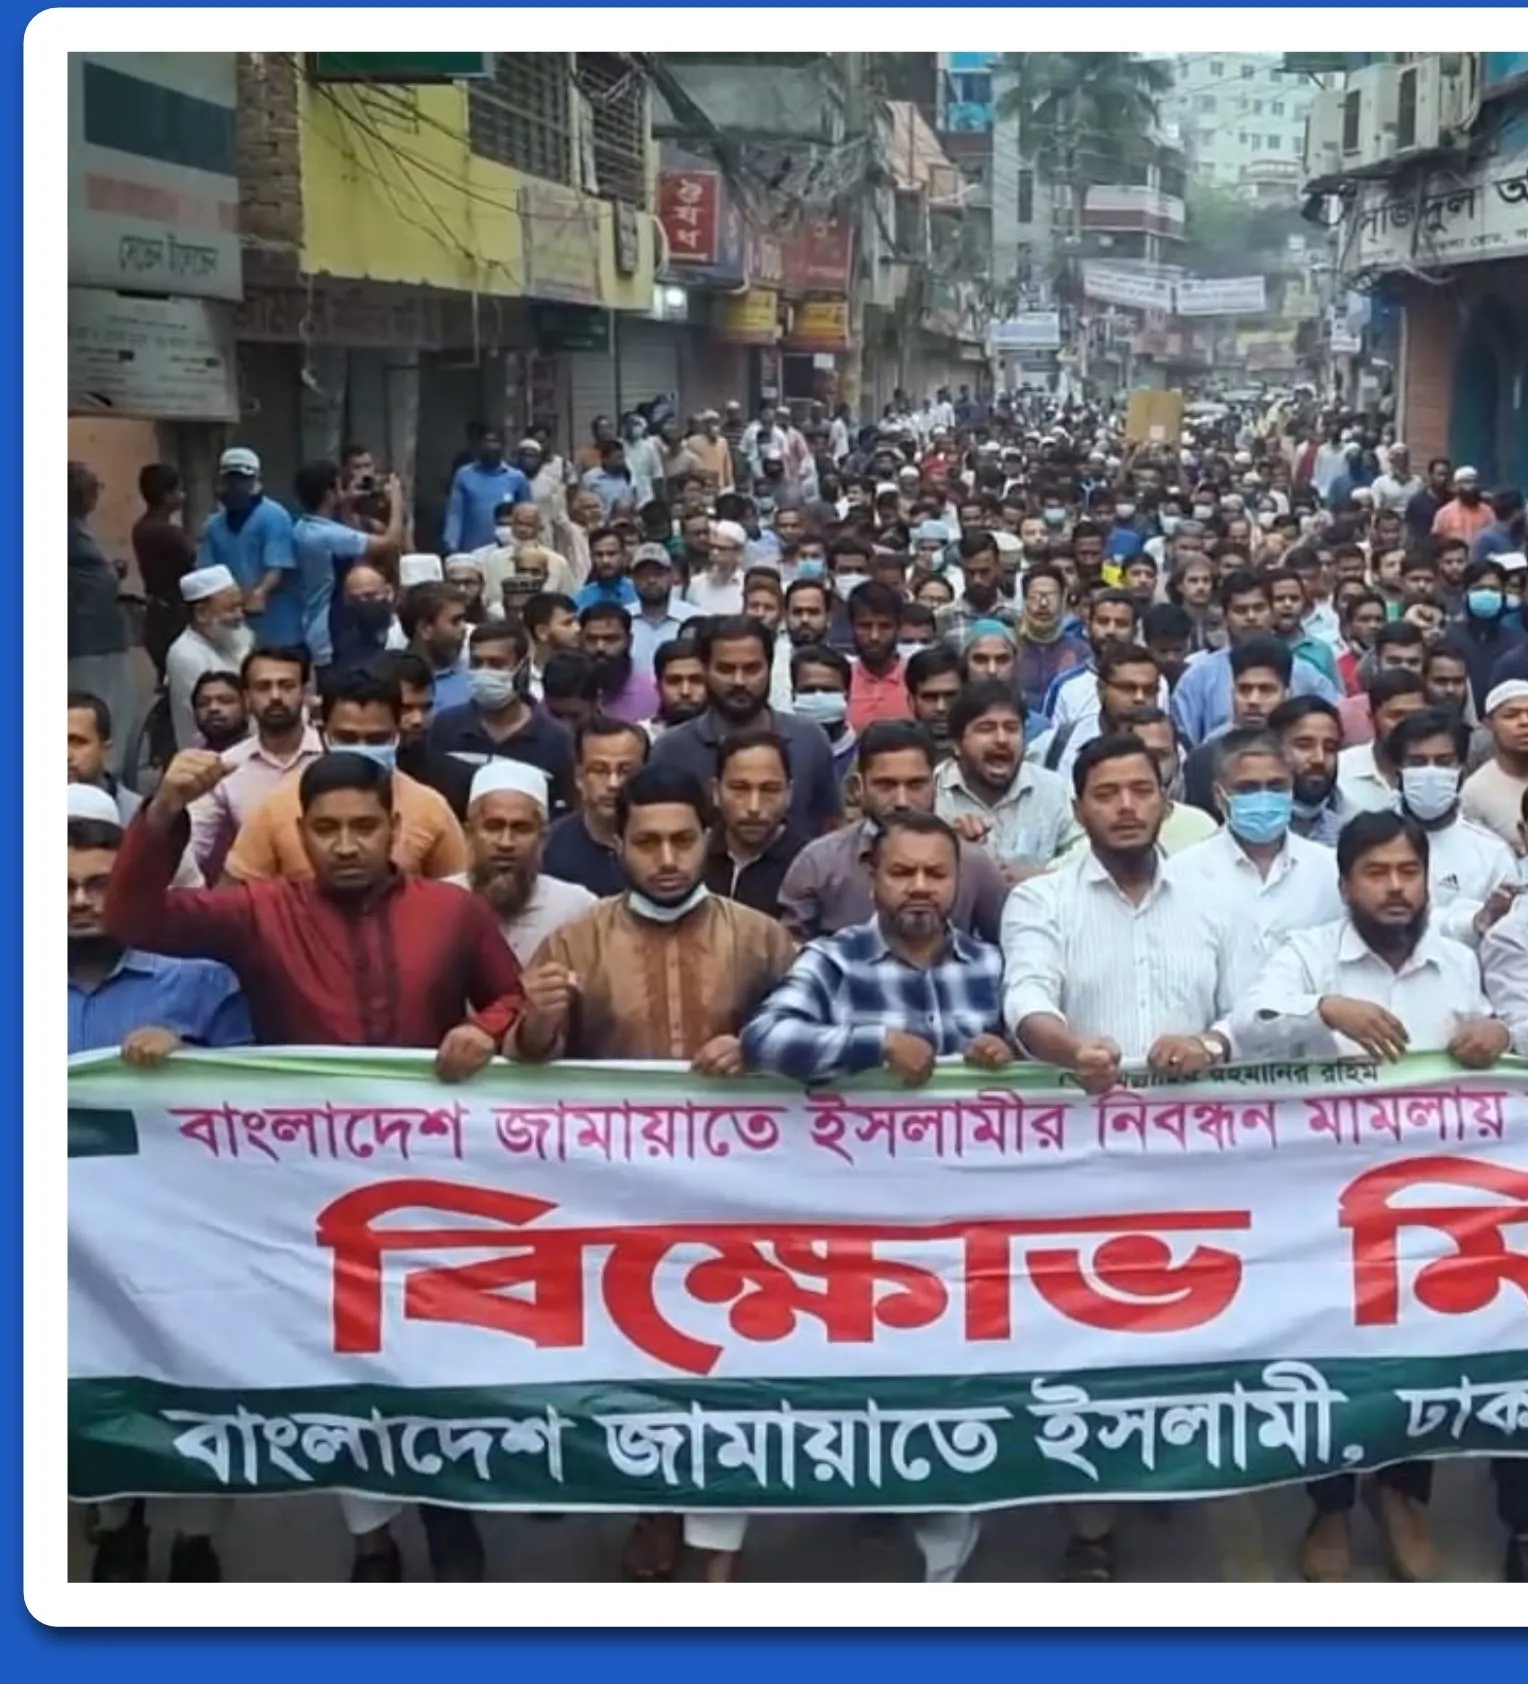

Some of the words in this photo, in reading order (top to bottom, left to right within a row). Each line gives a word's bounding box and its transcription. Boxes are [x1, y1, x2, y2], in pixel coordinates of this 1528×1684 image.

[169, 1102, 470, 1163] বাংলাদেশ
[491, 1102, 788, 1161] জামায়াতে
[805, 1087, 1073, 1165] ইসলামীর
[1096, 1085, 1282, 1151] নিবন্ধন
[1303, 1084, 1507, 1146] মামলায়
[315, 1178, 1252, 1377] বিক্ষোভ
[161, 1402, 577, 1485] বাংলাদেশ
[590, 1398, 1014, 1490] জামায়াতে
[1028, 1359, 1364, 1482] ইসলামী,
